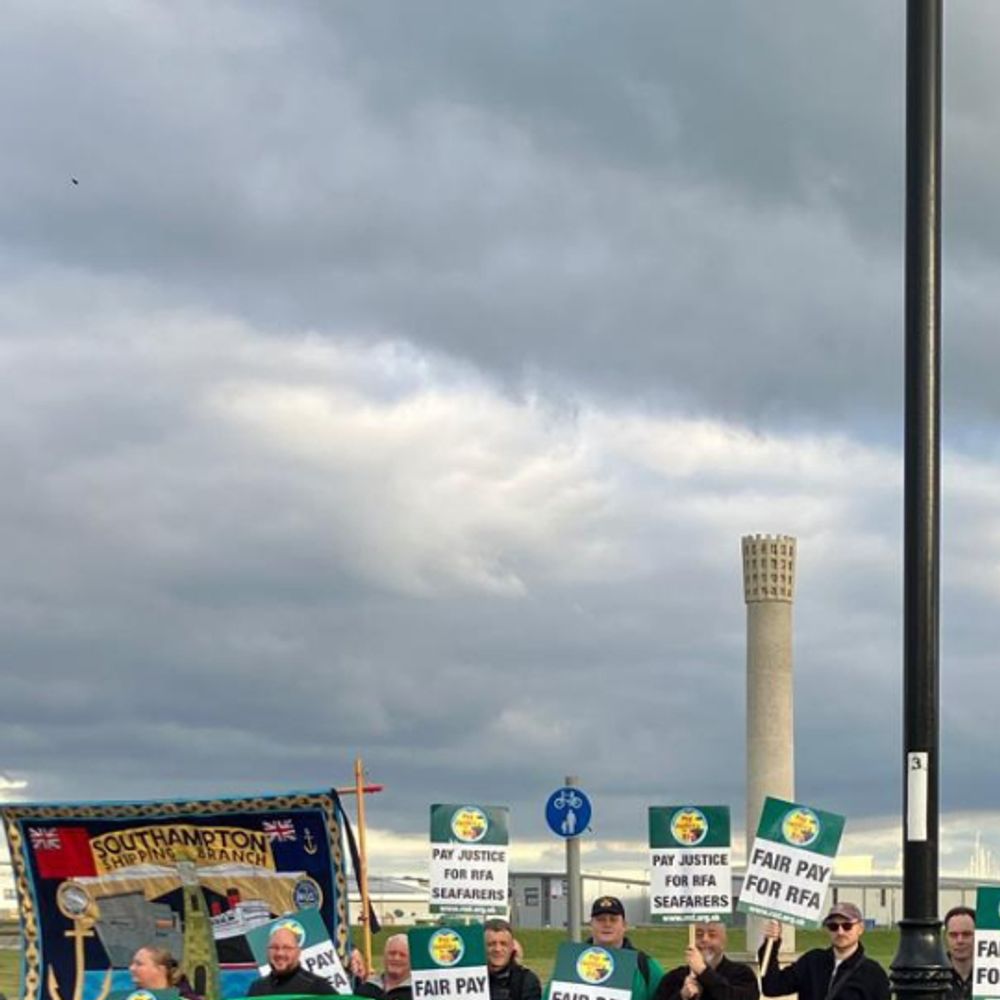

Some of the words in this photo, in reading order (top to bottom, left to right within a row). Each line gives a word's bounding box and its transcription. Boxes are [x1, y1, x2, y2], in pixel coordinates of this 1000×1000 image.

[911, 756, 922, 770] 3
[93, 827, 267, 858] SOUTHAMPTON
[101, 848, 175, 870] SHIPPING
[199, 849, 266, 867] BRANCH
[432, 848, 454, 860] PAY
[458, 850, 506, 862] JUSTICE
[652, 854, 675, 866] PAY
[678, 853, 728, 866] JUSTICE
[752, 849, 792, 874] FAIR
[795, 860, 830, 883] PAY
[444, 868, 467, 879] FOR
[471, 869, 494, 881] RFA
[665, 874, 688, 887] FOR
[692, 874, 717, 886] RFA
[432, 887, 505, 901] SEAFARERS
[745, 875, 782, 899] FOR
[785, 886, 820, 910] RFA
[653, 895, 729, 908] SEAFARERS
[305, 949, 335, 972] PAY
[415, 979, 451, 997] FAIR
[455, 976, 486, 994] PAY
